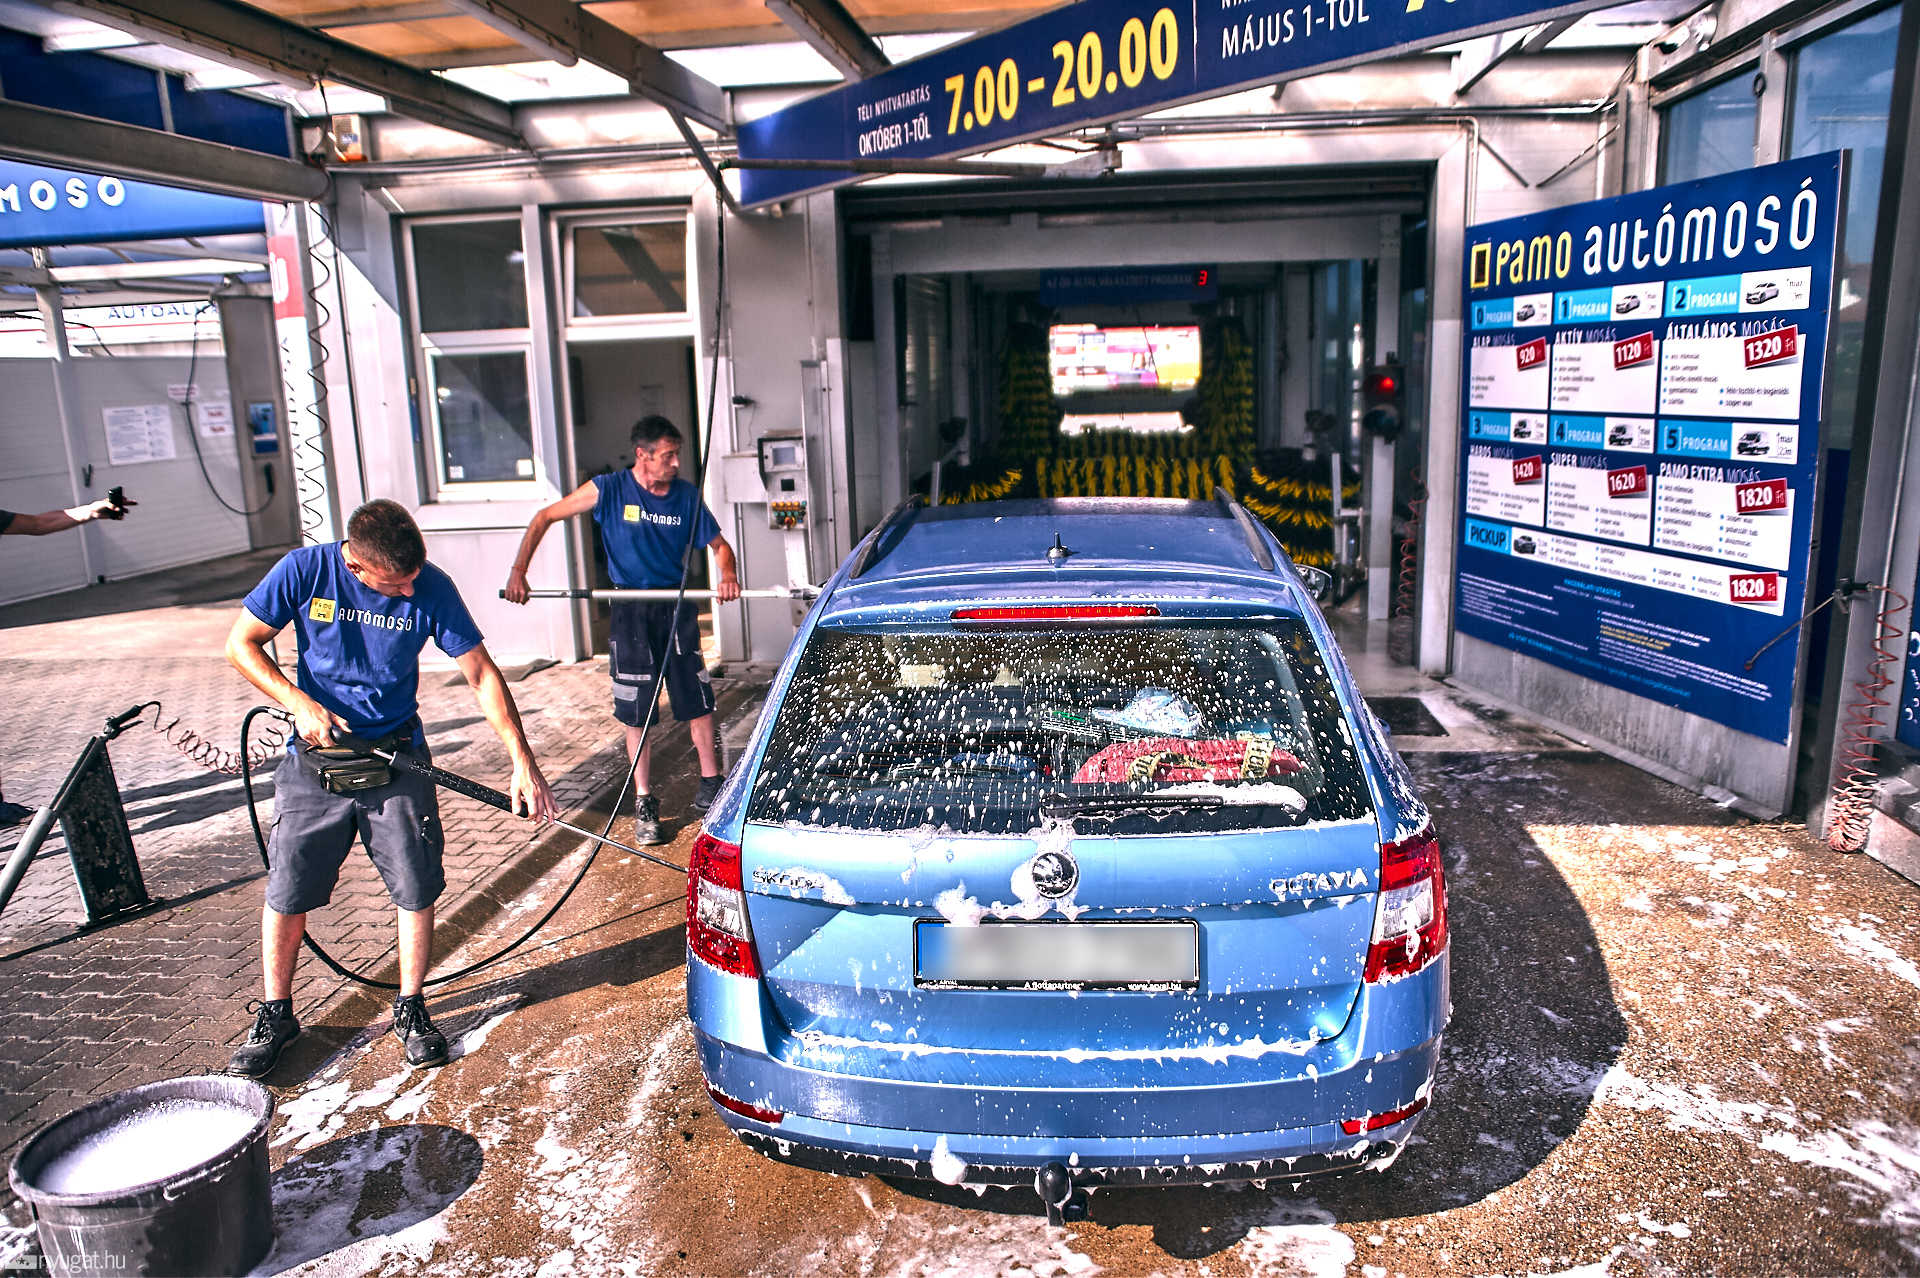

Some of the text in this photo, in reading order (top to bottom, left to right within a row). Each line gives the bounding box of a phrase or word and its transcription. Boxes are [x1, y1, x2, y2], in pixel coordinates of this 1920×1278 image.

[1221, 8, 1294, 59] MÁJUS
[944, 57, 1019, 135] 7.00
[1051, 7, 1179, 107] 20.00
[857, 84, 930, 121] TÉLI NYITVATARTÁS
[859, 112, 931, 156] OKTÓBER 1-TŐL
[1198, 270, 1208, 286] 3
[1691, 290, 1738, 308] PROGRAM
[1573, 302, 1608, 317] PROGRAM
[1554, 328, 1583, 345] AKTÍV
[1666, 319, 1737, 340] ÁLTALÁNOS
[1519, 346, 1536, 364] 920
[1616, 341, 1642, 363] 1120
[1746, 336, 1782, 362] 1320
[1568, 428, 1602, 444] PROGRAM
[1682, 436, 1728, 452] PROGRAM
[1514, 462, 1534, 479] 1420
[1660, 462, 1688, 479] PAMO
[1690, 464, 1724, 483] EXTRA
[1609, 472, 1636, 492] 1620
[1738, 486, 1773, 507] 1820
[1731, 578, 1765, 598] 1820
[1269, 867, 1369, 894] OCTAVIA
